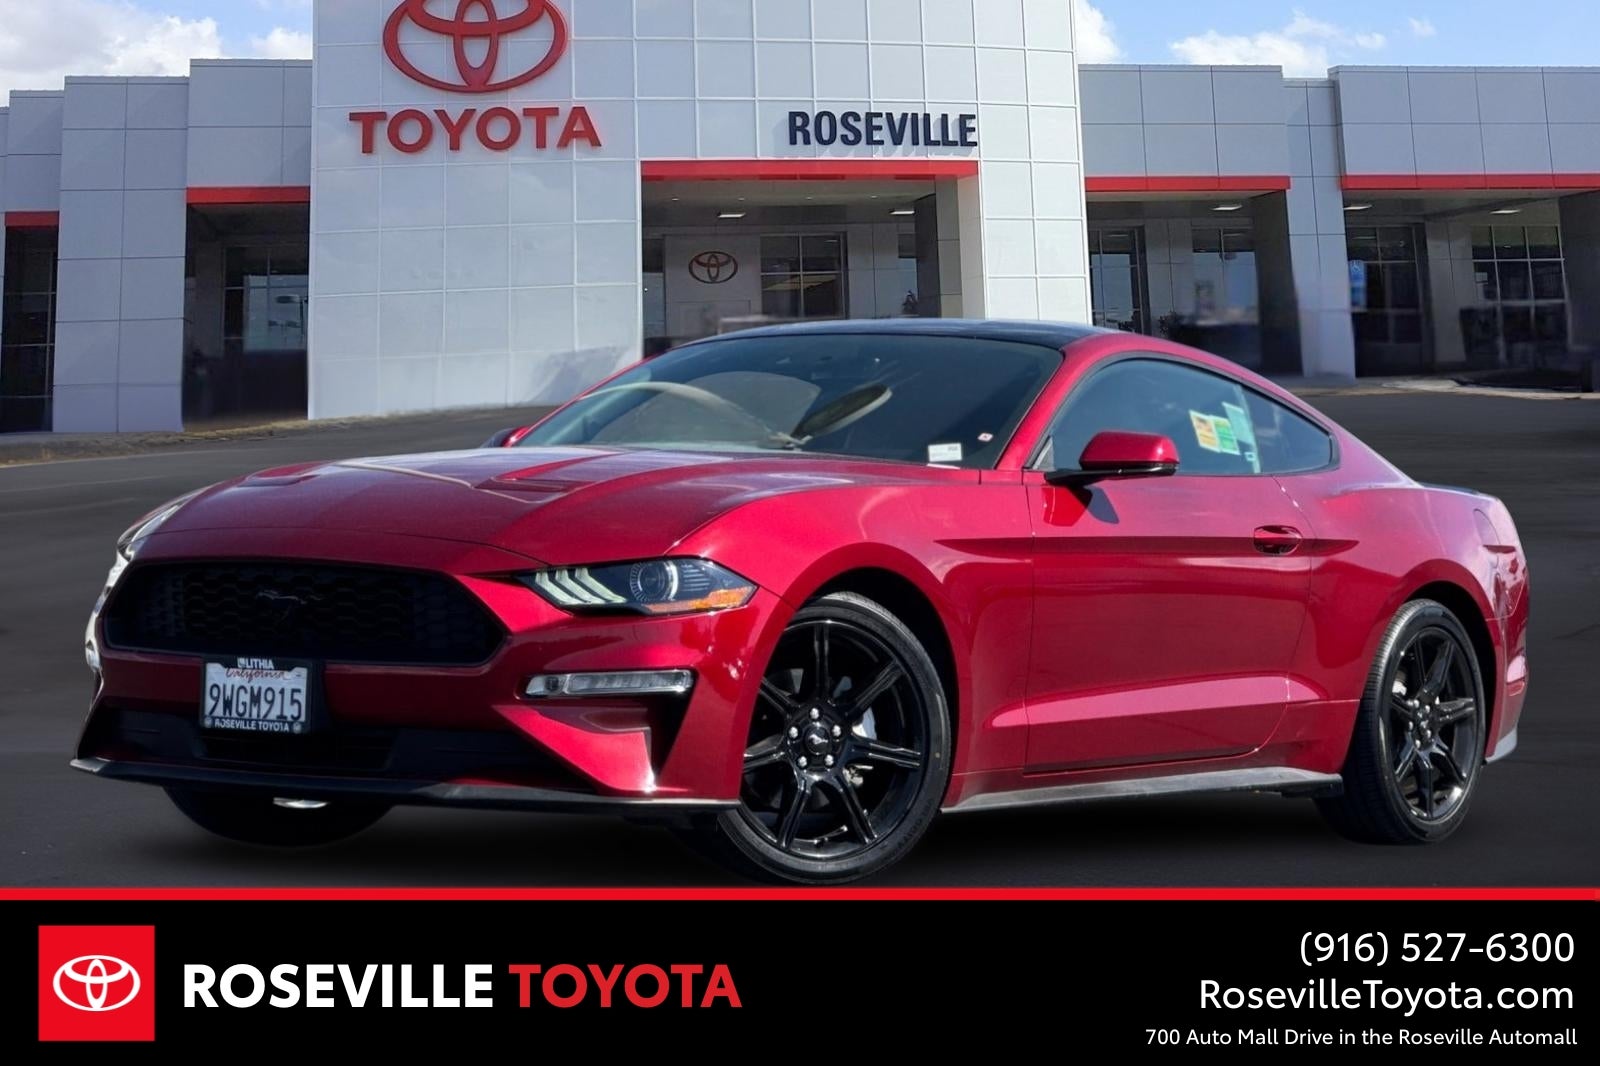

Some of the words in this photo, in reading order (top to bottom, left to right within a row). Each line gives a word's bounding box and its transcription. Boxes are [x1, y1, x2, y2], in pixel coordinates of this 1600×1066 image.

[348, 106, 602, 154] TOYOTA
[788, 111, 978, 147] ROSEVILLE
[246, 658, 274, 669] LITHIA
[209, 683, 302, 720] 9WGM915
[214, 718, 256, 730] ROSEVILLE
[259, 721, 290, 732] TOYOTA
